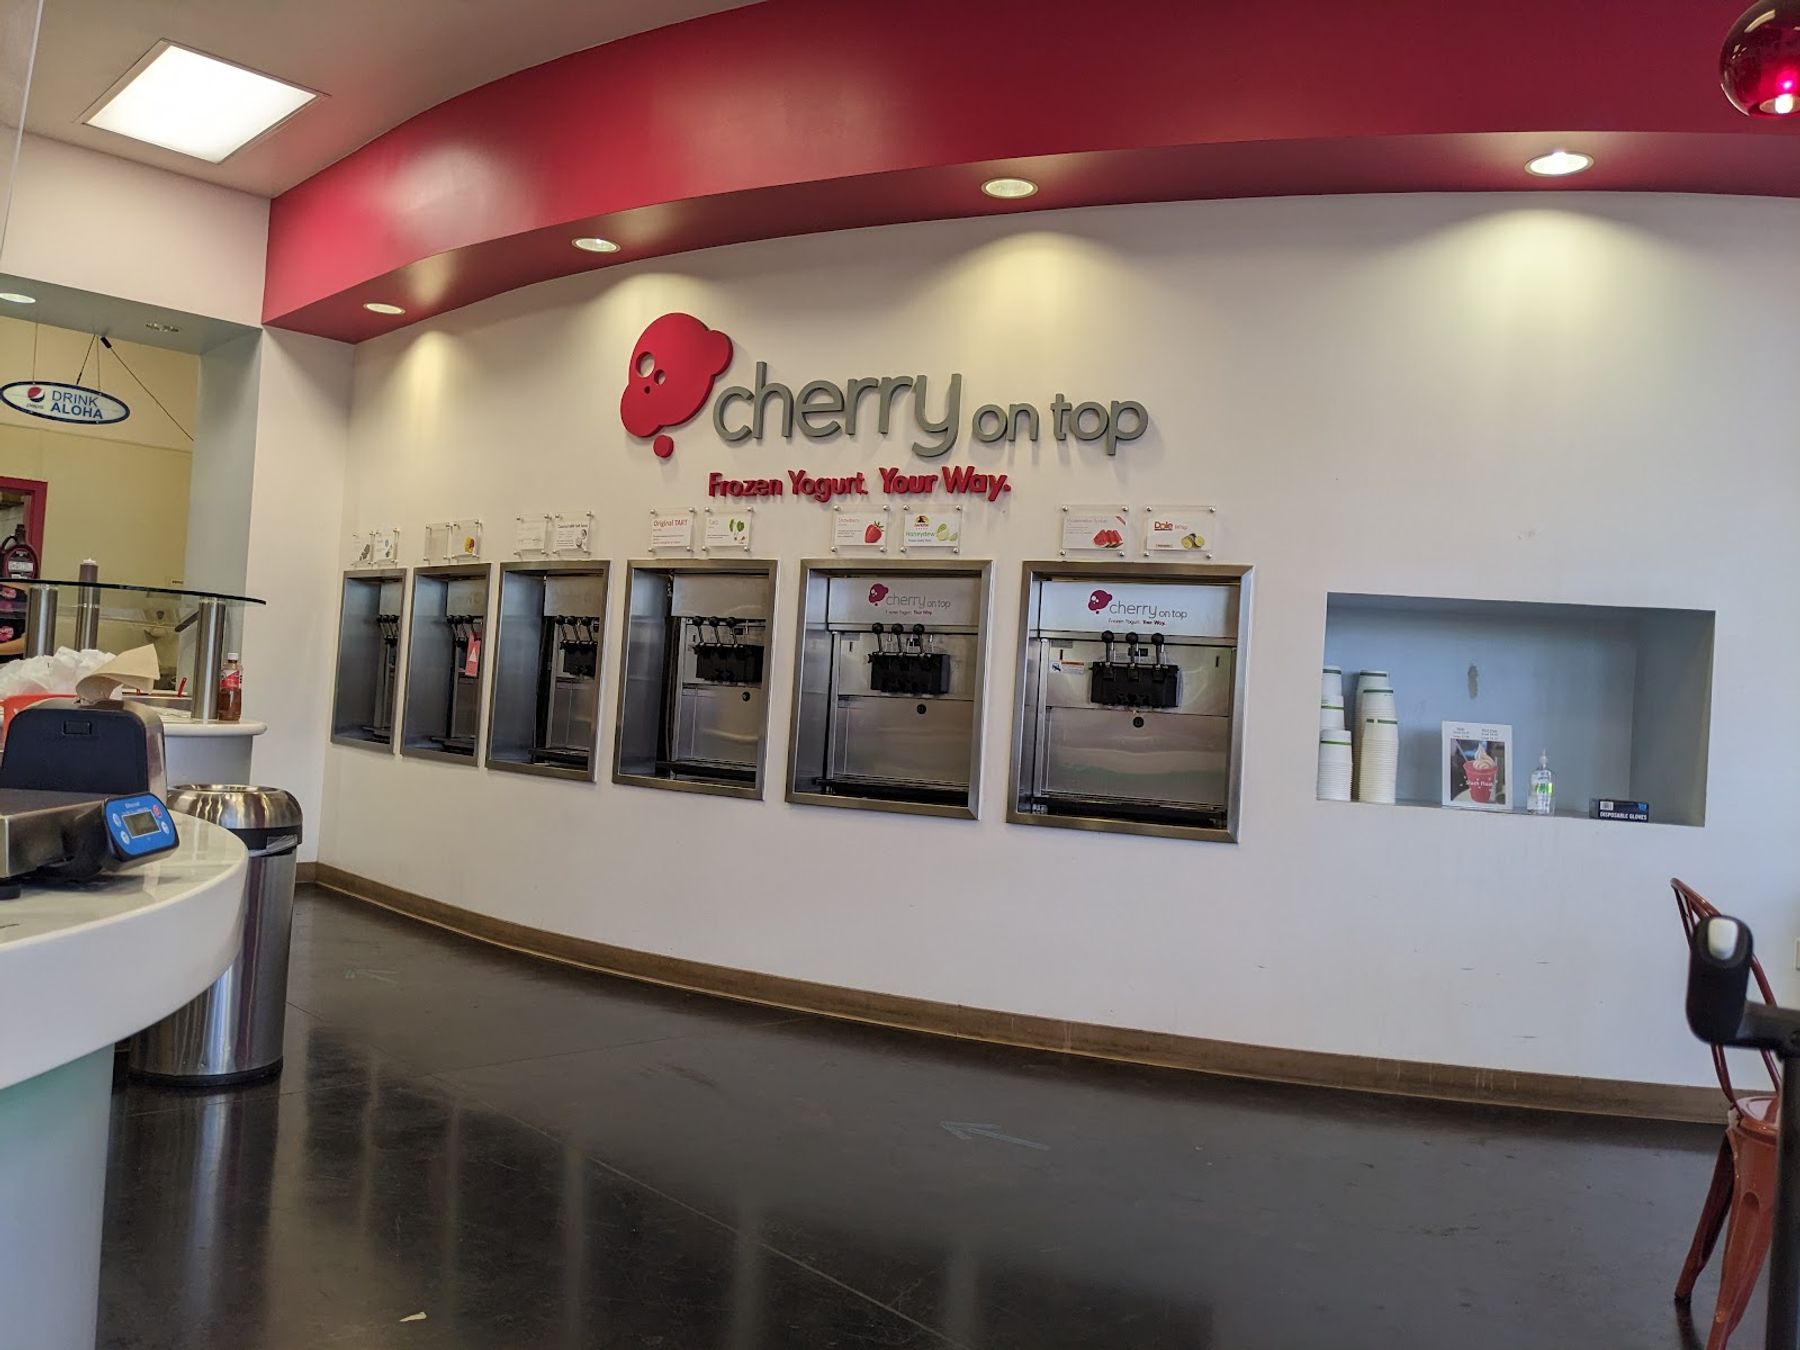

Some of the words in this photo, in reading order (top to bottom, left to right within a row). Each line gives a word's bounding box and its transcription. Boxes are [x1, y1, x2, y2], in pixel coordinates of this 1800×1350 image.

[52, 390, 98, 407] DRINK
[50, 403, 103, 419] ALOHA
[712, 361, 962, 457] cherry
[971, 403, 1040, 442] on
[1050, 393, 1149, 456] top
[708, 472, 784, 497] Frozen
[879, 467, 939, 494] Your
[942, 465, 1011, 501] Way.
[1154, 520, 1173, 530] Dole
[886, 592, 926, 609] cherry
[927, 600, 938, 608] on
[938, 599, 951, 610] top
[1109, 600, 1157, 619] cherry
[1158, 610, 1171, 618] on
[1172, 609, 1188, 620] top
[1629, 812, 1647, 821] GLOVES
